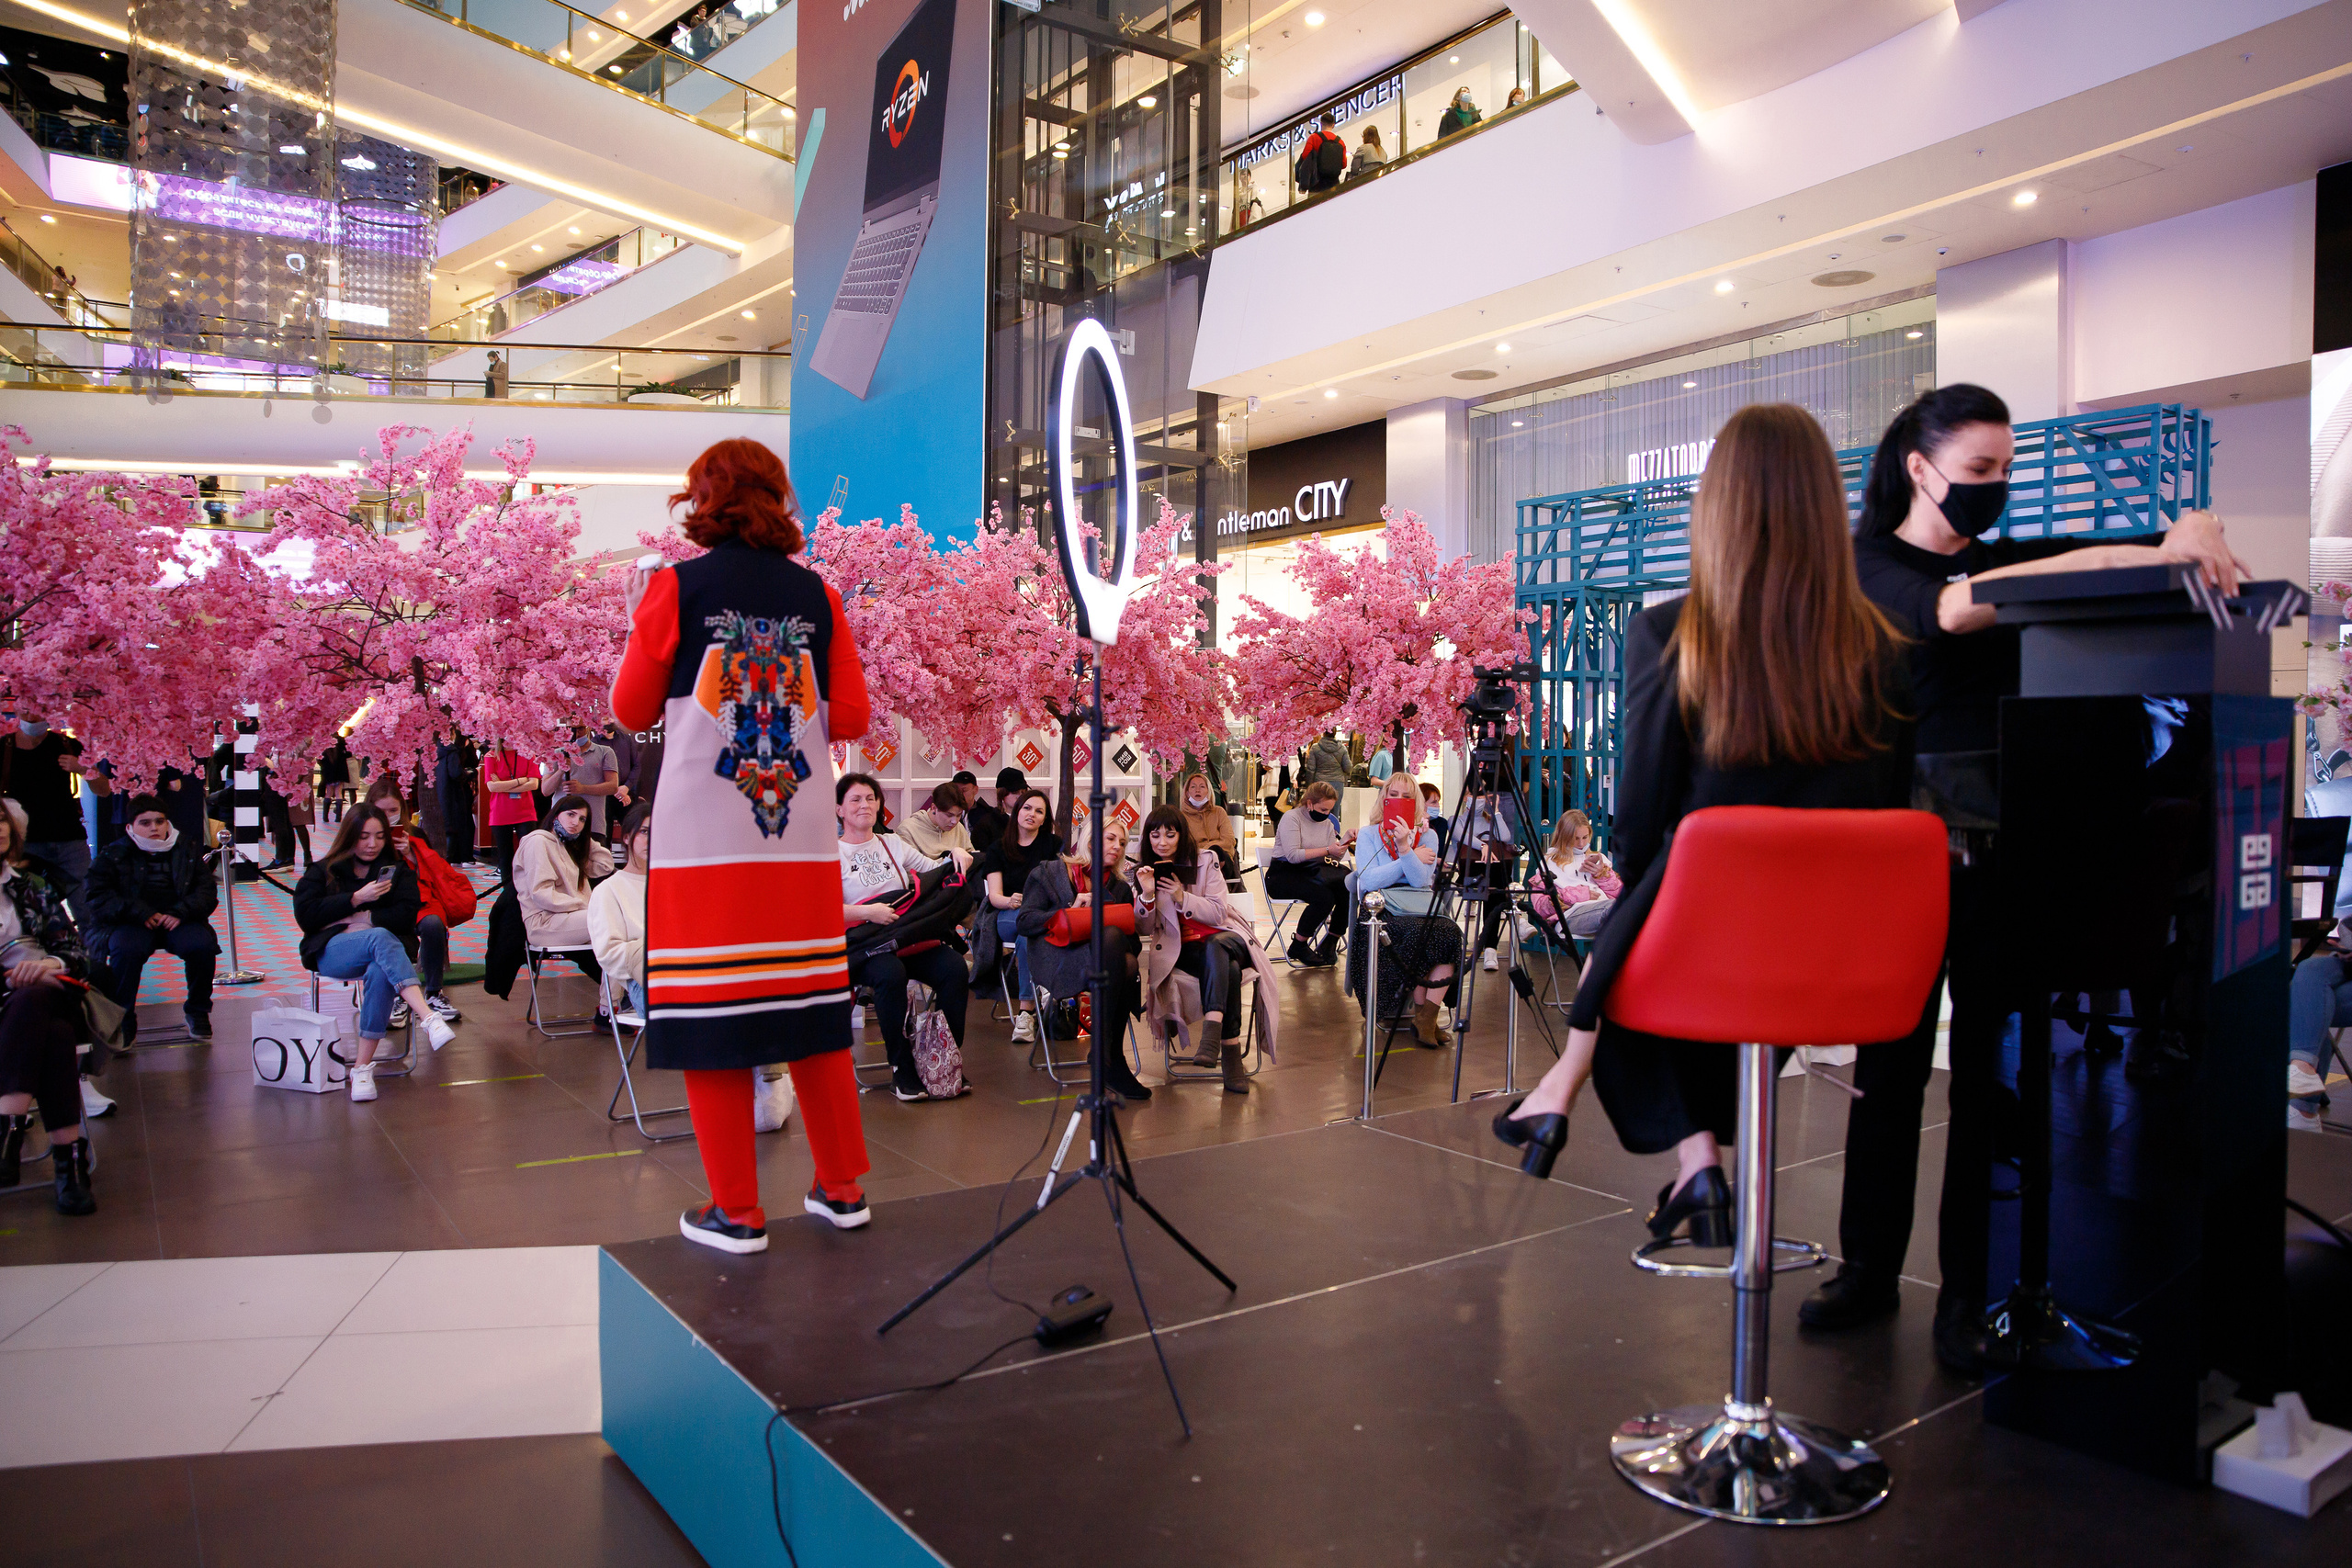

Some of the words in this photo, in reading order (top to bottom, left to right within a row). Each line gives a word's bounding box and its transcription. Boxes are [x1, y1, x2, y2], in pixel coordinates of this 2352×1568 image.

[881, 70, 929, 132] RYZEN
[1308, 74, 1401, 135] SENCER
[1217, 506, 1290, 536] ntleman
[1295, 478, 1348, 523] CITY
